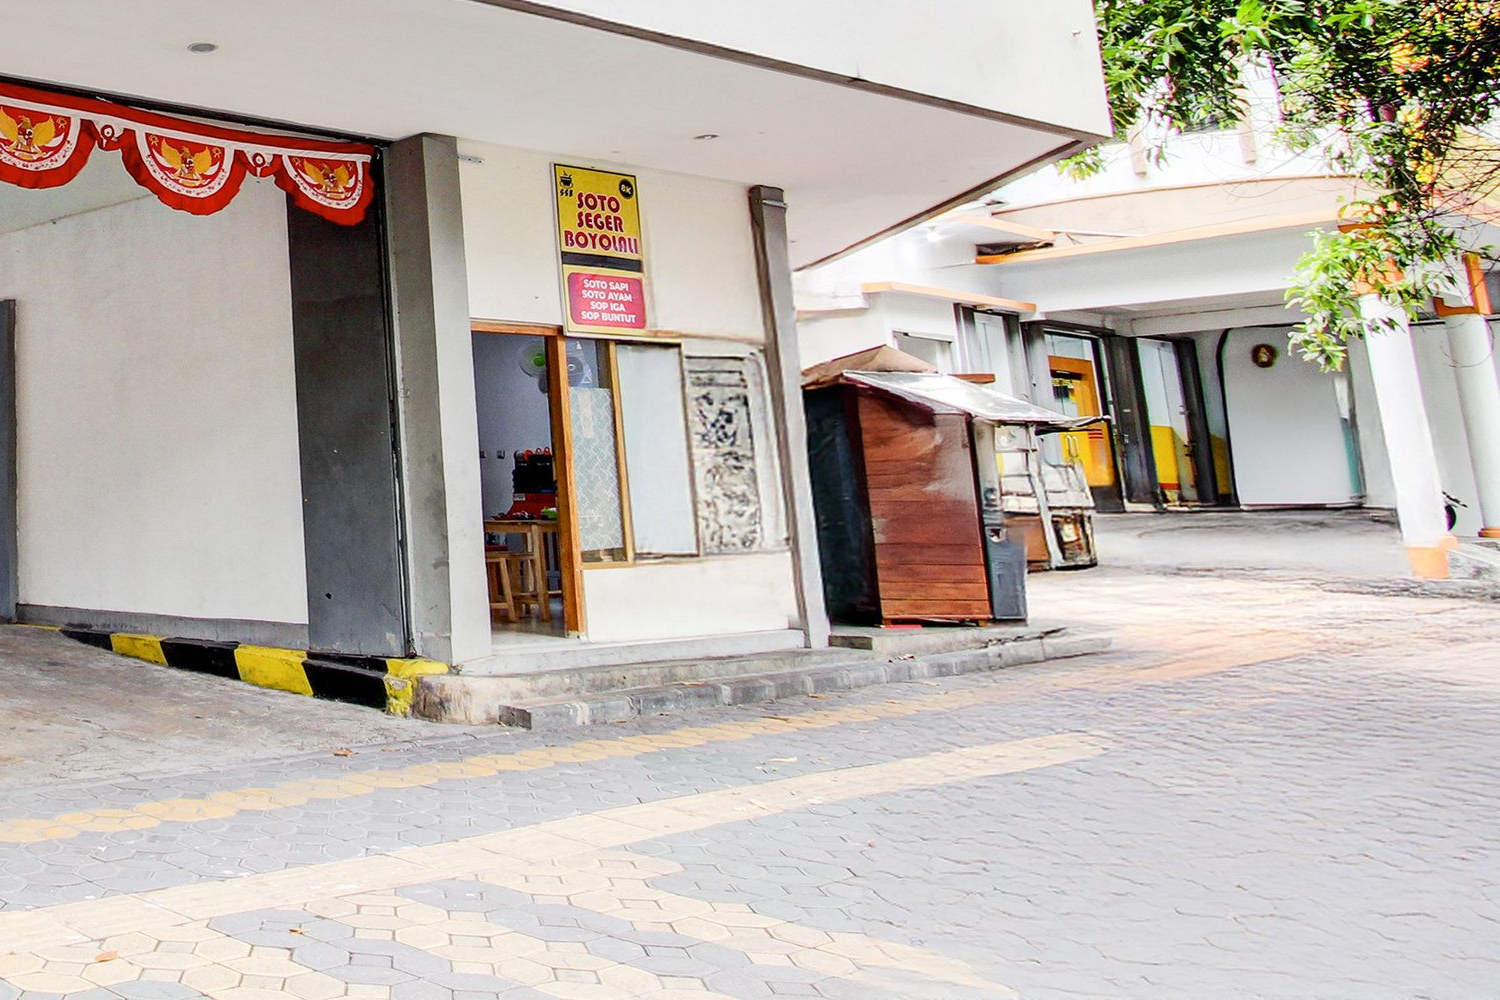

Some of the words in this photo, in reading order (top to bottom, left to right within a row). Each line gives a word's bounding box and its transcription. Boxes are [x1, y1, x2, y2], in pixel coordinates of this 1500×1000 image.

[577, 192, 621, 214] SOTO
[577, 211, 624, 232] SEGER
[564, 230, 638, 254] BOYOLALI
[583, 279, 608, 289] SOTO
[609, 281, 629, 291] SAPI
[581, 289, 606, 299] SOTO
[607, 292, 633, 302] AYAM
[590, 300, 608, 310] SOP
[610, 302, 626, 312] IGA
[581, 310, 600, 320] SOP
[601, 312, 636, 323] BUNTUT
